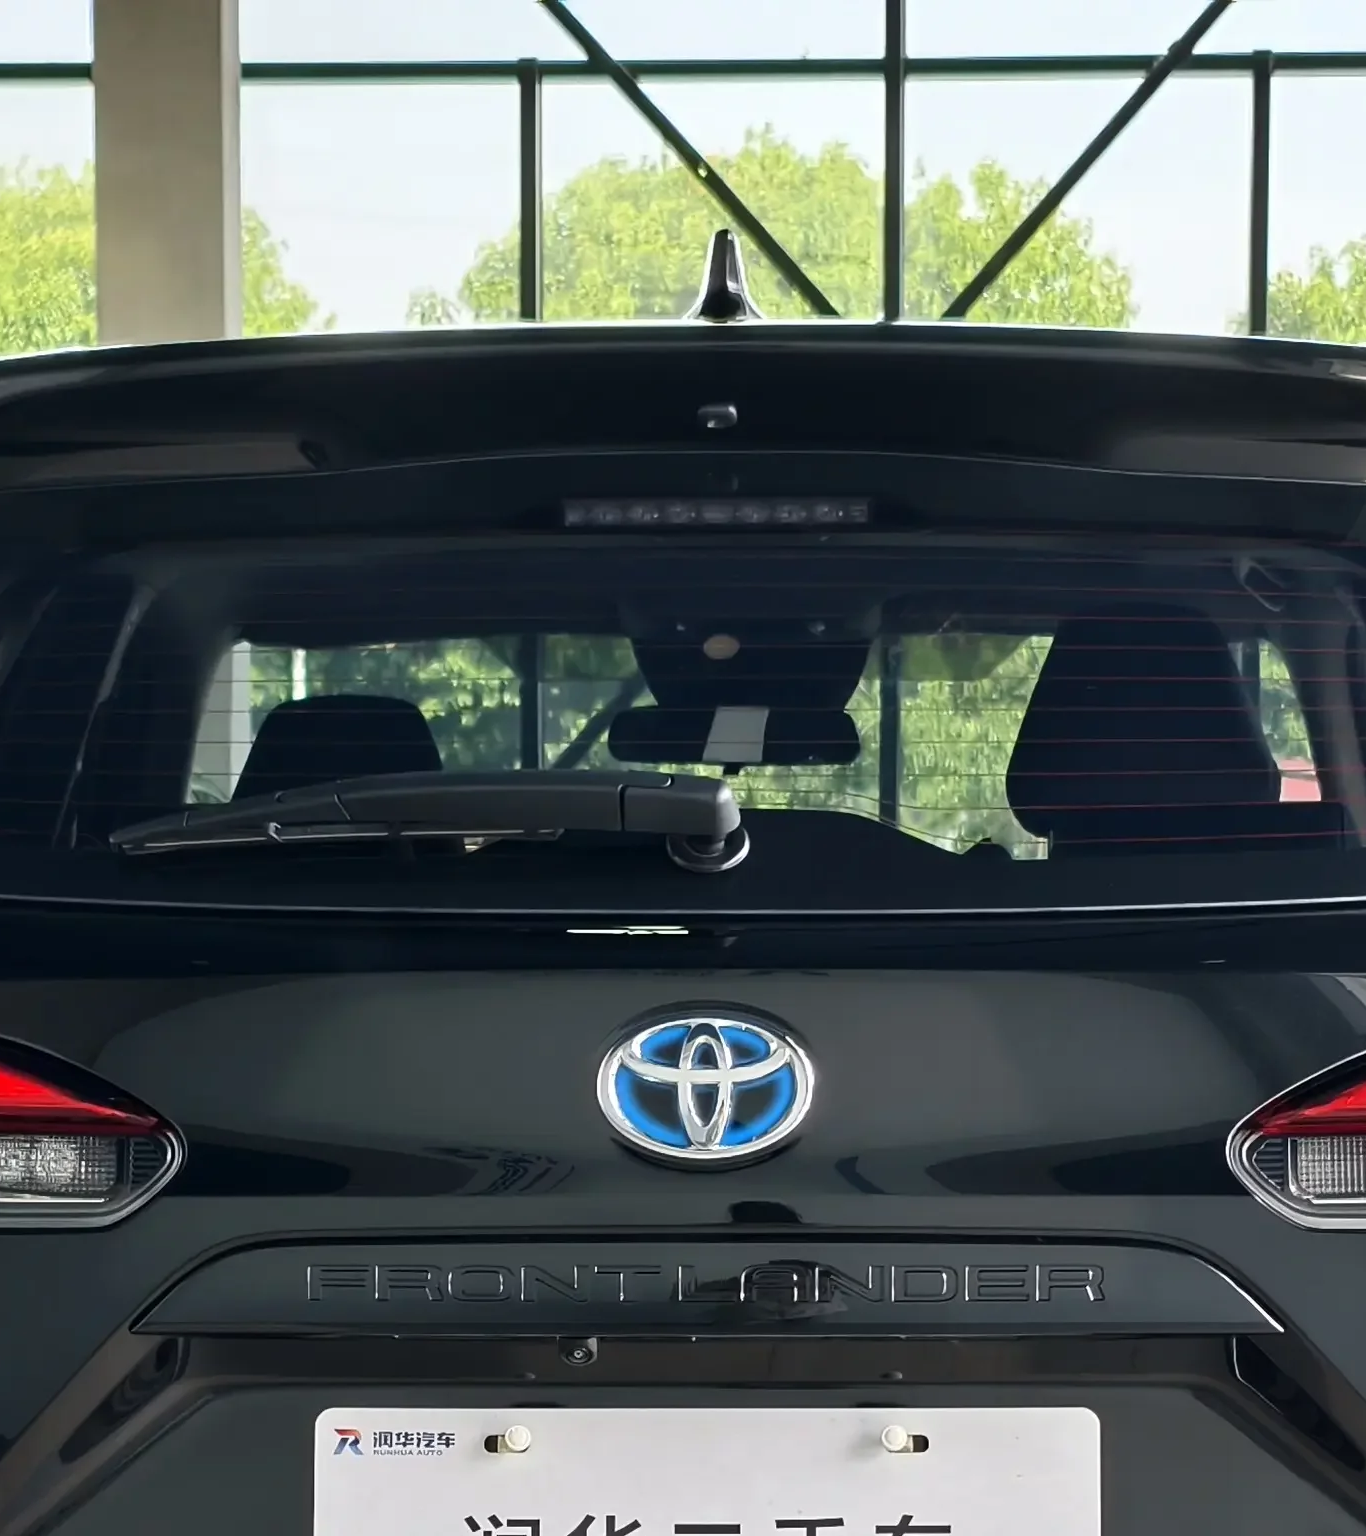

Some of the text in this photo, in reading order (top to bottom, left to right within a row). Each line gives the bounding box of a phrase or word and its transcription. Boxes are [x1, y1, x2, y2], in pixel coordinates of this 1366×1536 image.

[307, 1263, 1106, 1303] FRONTLANDER
[373, 1431, 456, 1449] 润华汽车
